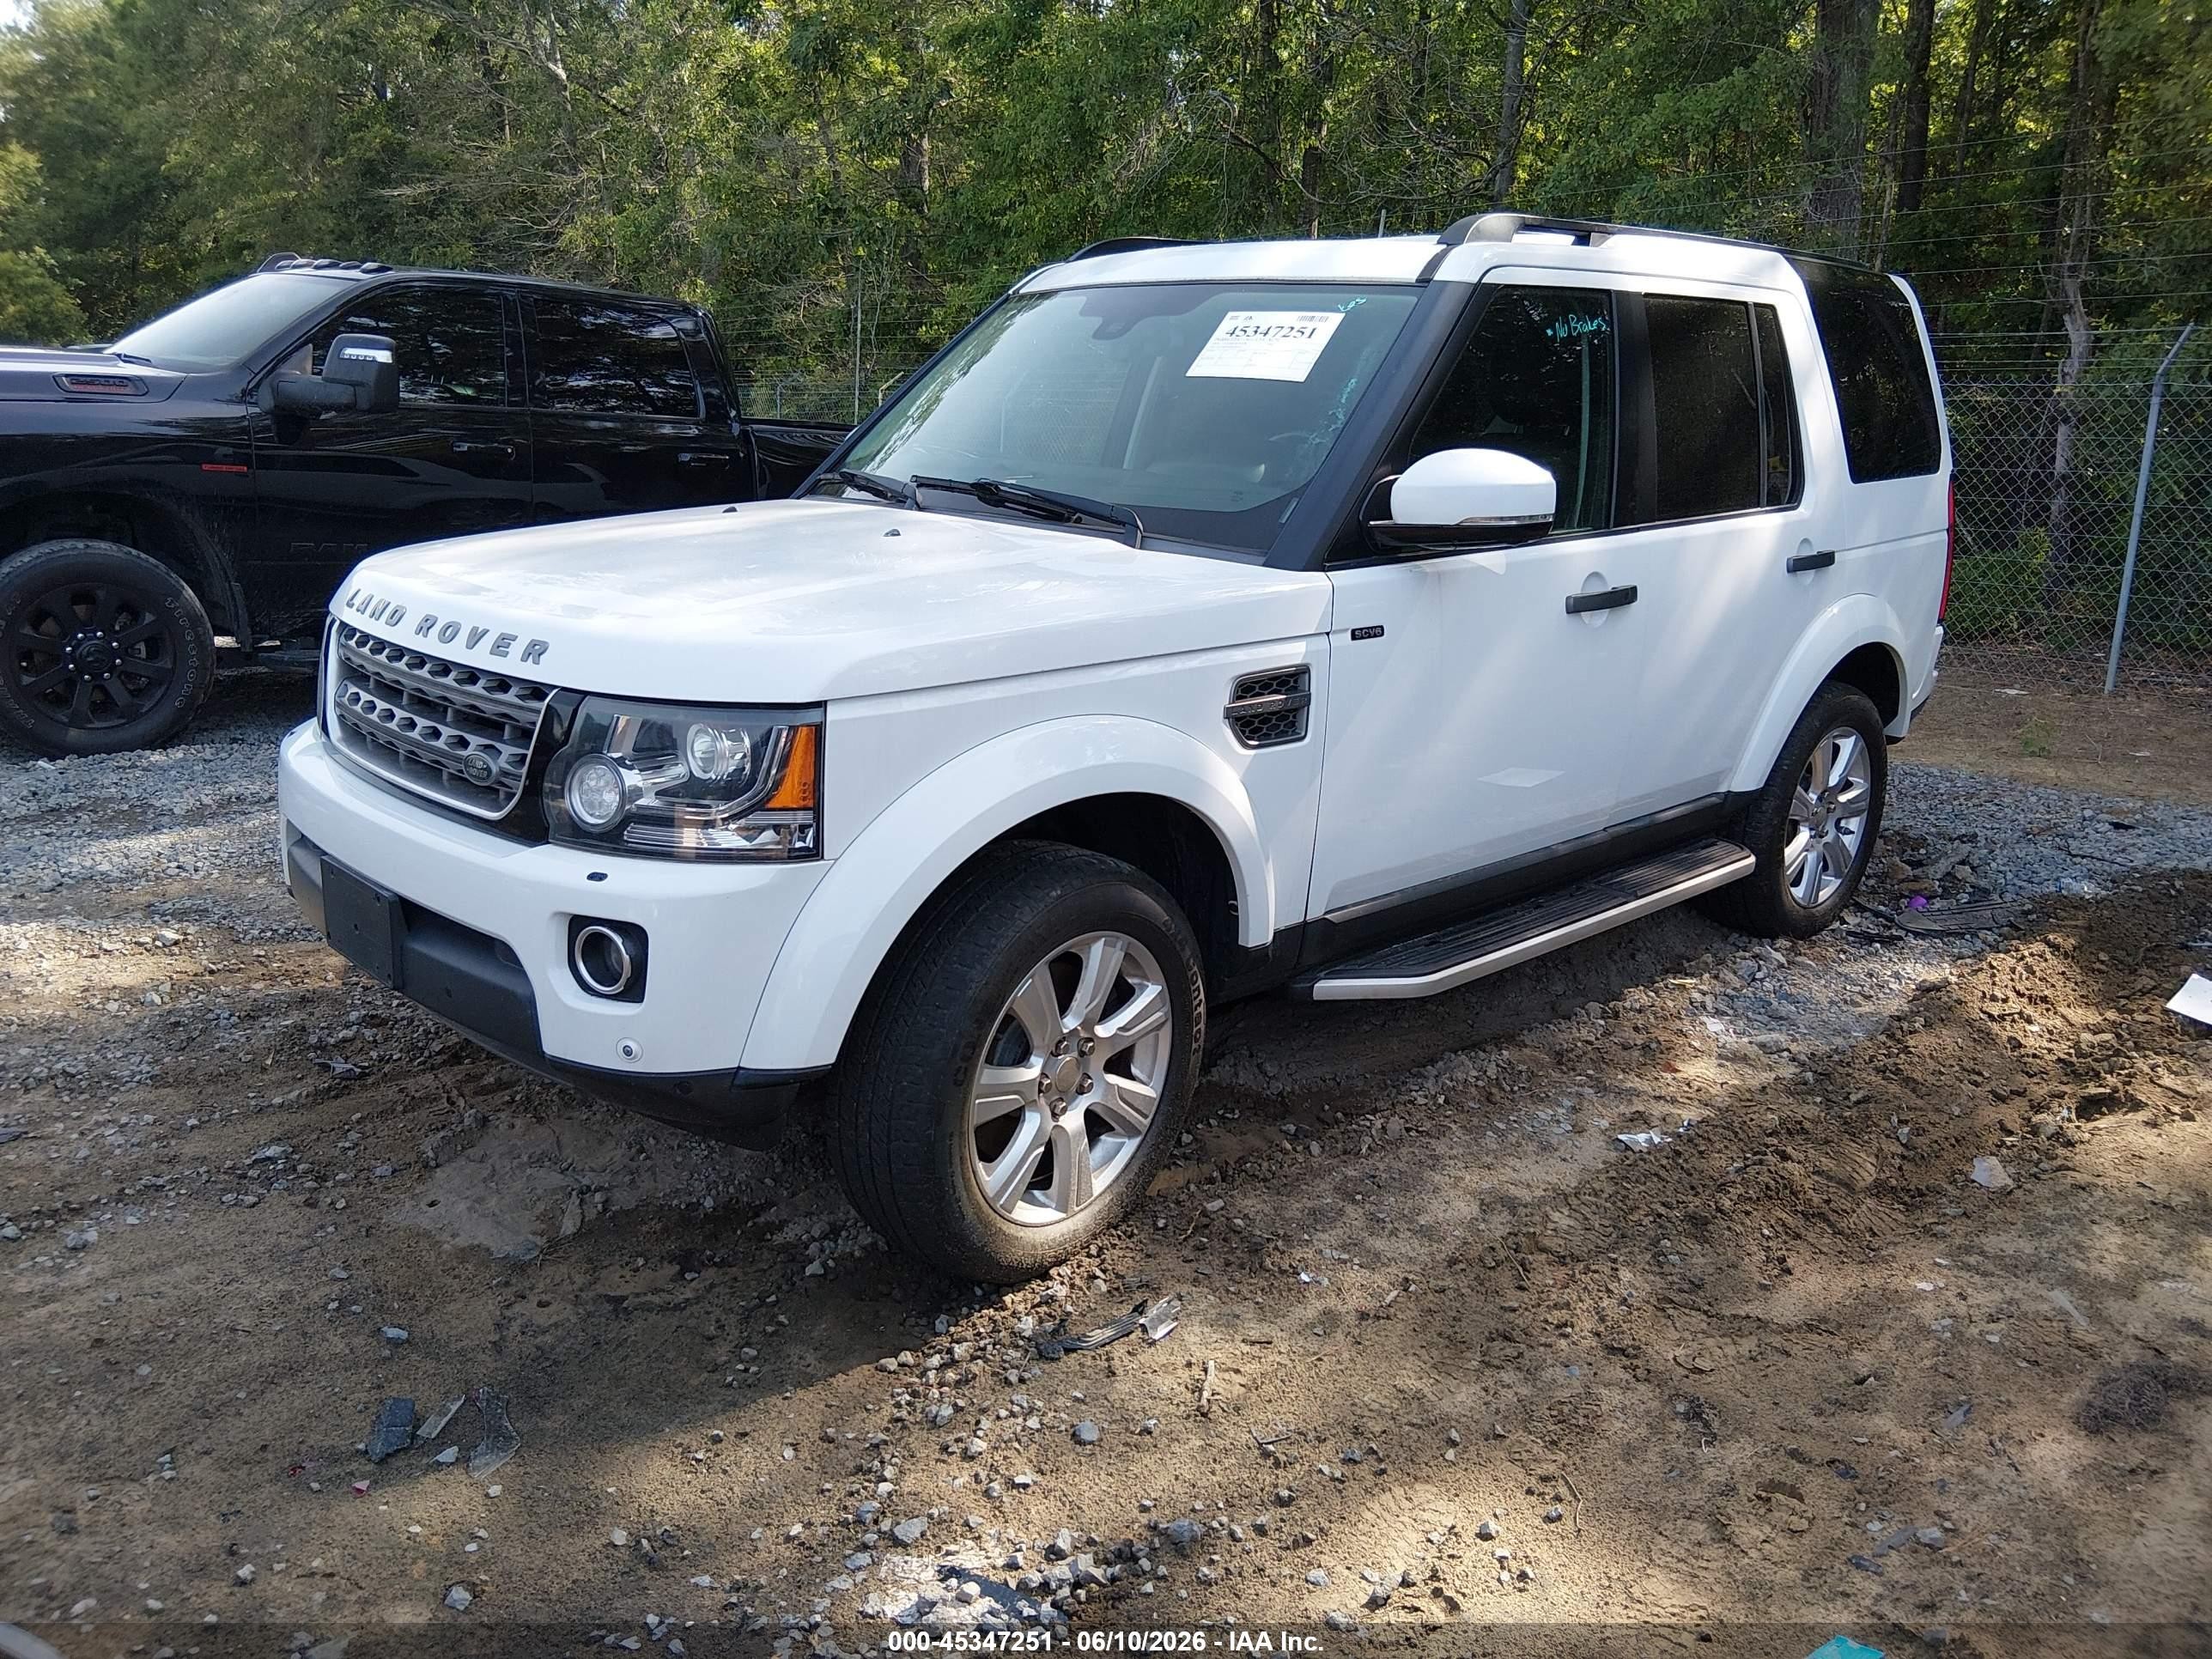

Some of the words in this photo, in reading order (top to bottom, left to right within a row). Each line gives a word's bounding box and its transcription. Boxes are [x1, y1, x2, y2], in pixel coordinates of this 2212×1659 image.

[1224, 325, 1318, 339] 45347251
[345, 588, 407, 627] LAND
[414, 613, 550, 665] ROVER
